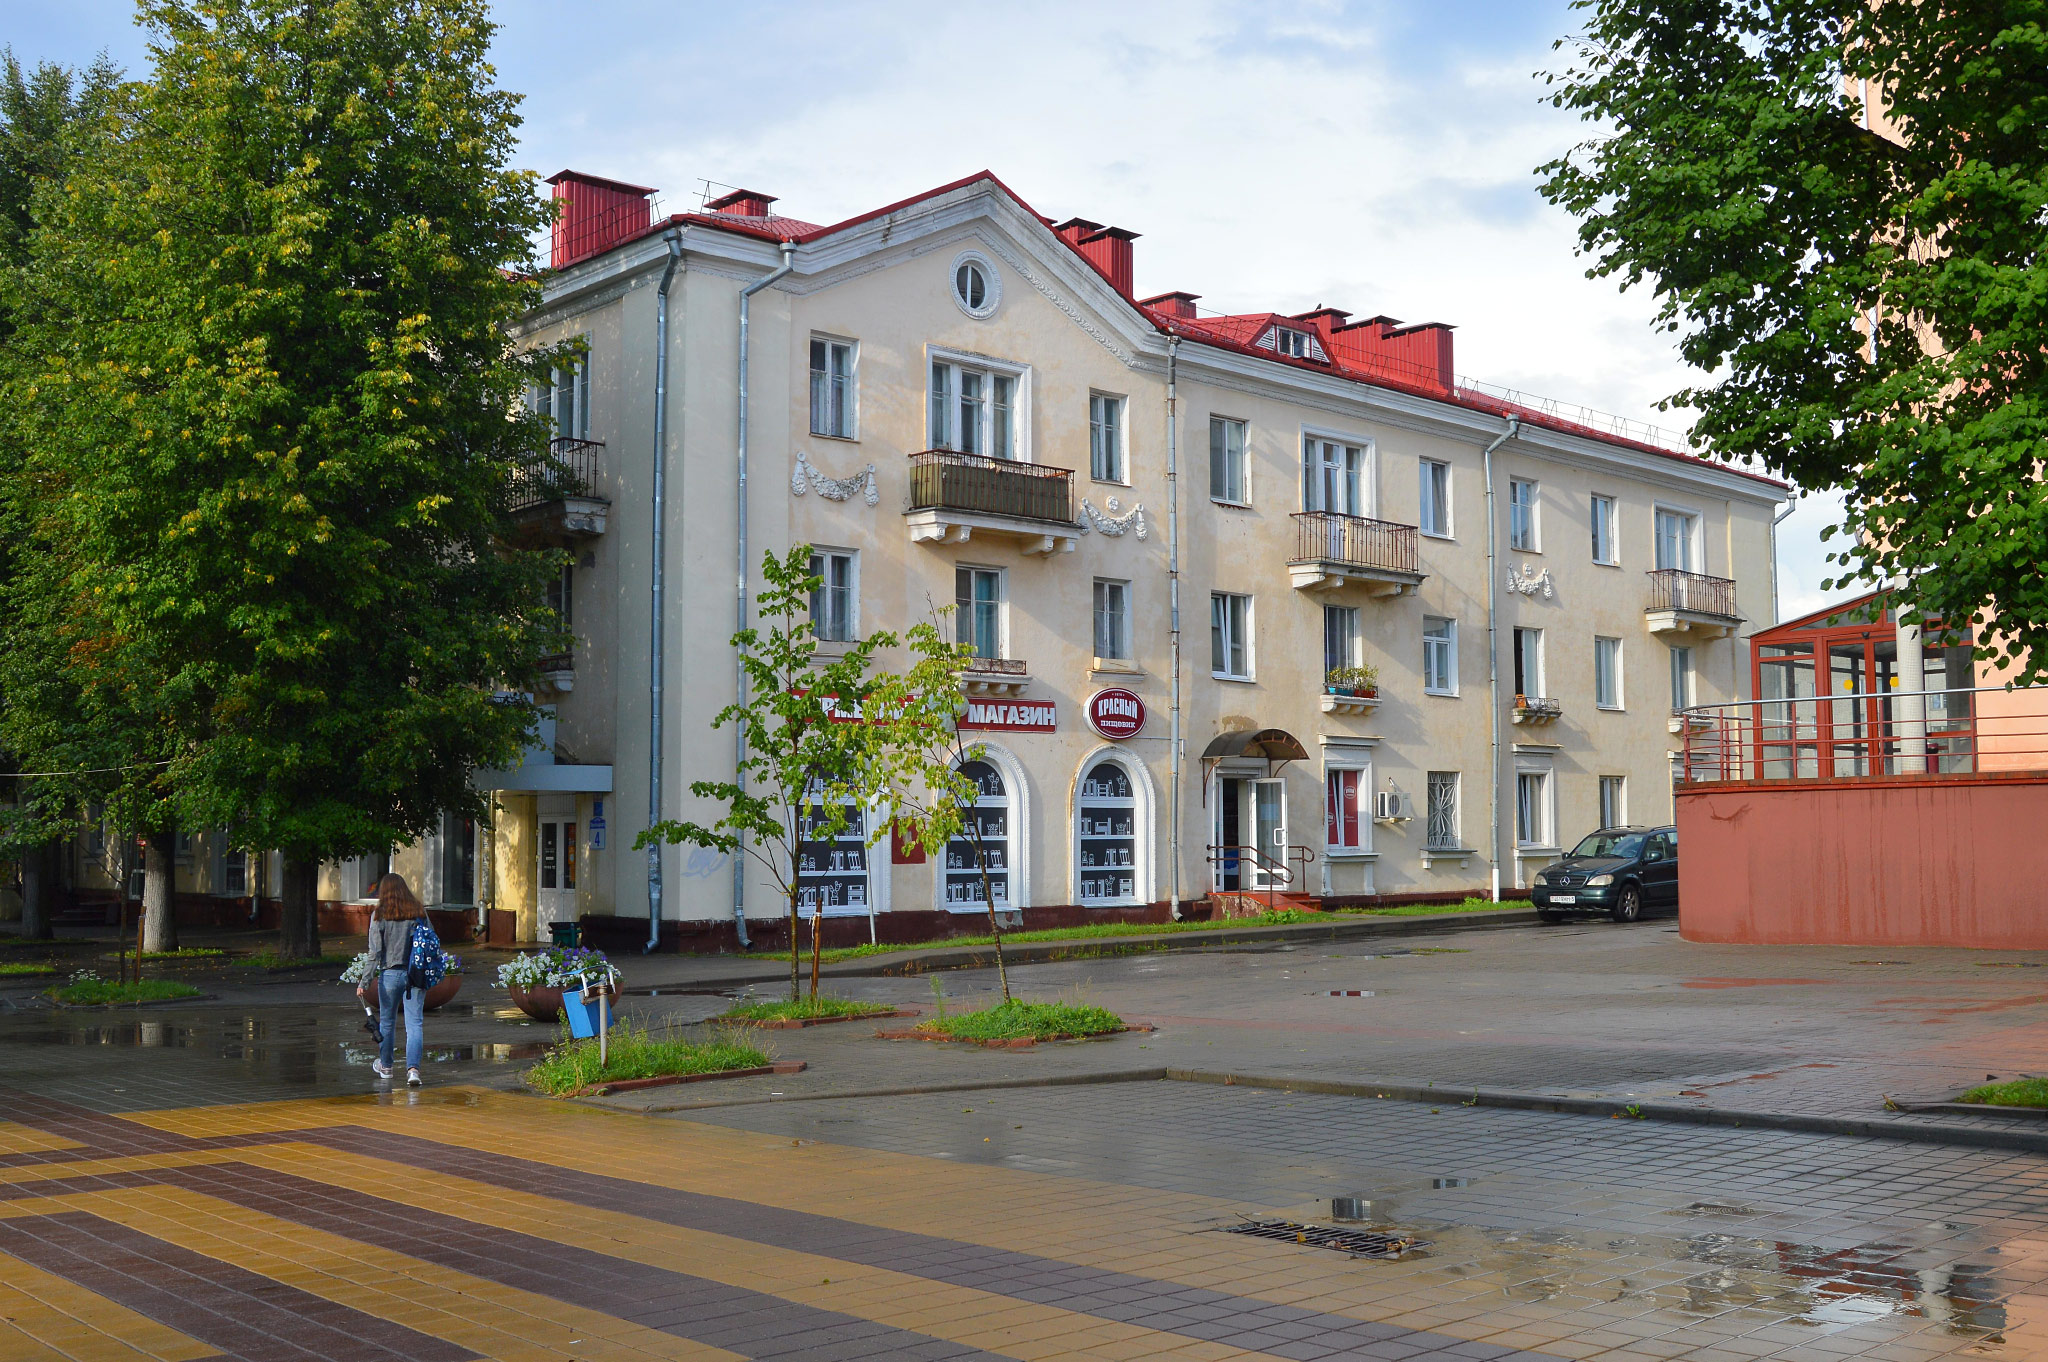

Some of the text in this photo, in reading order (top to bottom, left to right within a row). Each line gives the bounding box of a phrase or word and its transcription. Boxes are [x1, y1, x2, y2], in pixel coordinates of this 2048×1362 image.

[967, 704, 1056, 726] МАГАЗИН
[1098, 697, 1138, 720] КРАСНЫЙ
[1100, 720, 1136, 728] ПИЩОВИК
[594, 831, 600, 847] 4
